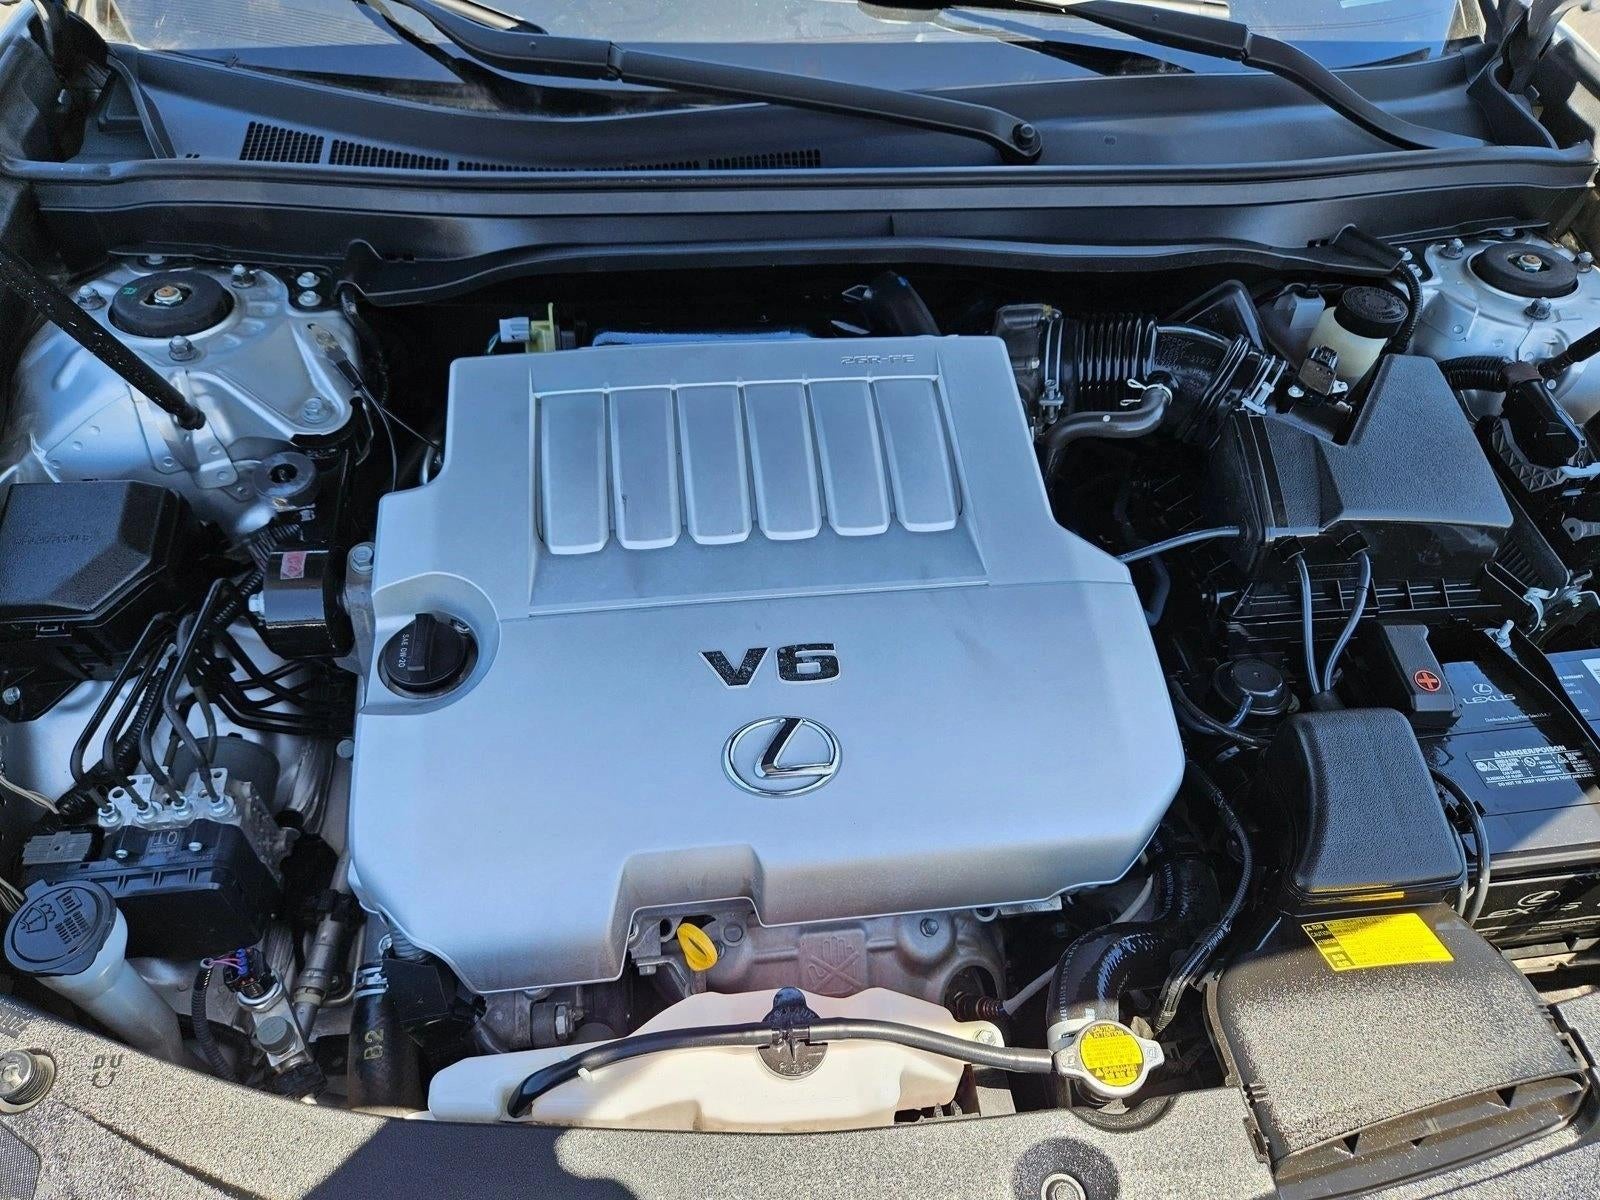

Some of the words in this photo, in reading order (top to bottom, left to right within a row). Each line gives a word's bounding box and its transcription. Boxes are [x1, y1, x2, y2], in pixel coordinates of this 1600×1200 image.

[840, 354, 915, 364] 2GR-FE
[401, 633, 410, 646] SAE
[398, 647, 408, 668] 0W-20
[698, 642, 841, 690] V6
[1462, 693, 1516, 705] LEXUS
[1500, 744, 1567, 757] DANGER/POISON
[363, 1028, 385, 1060] B2
